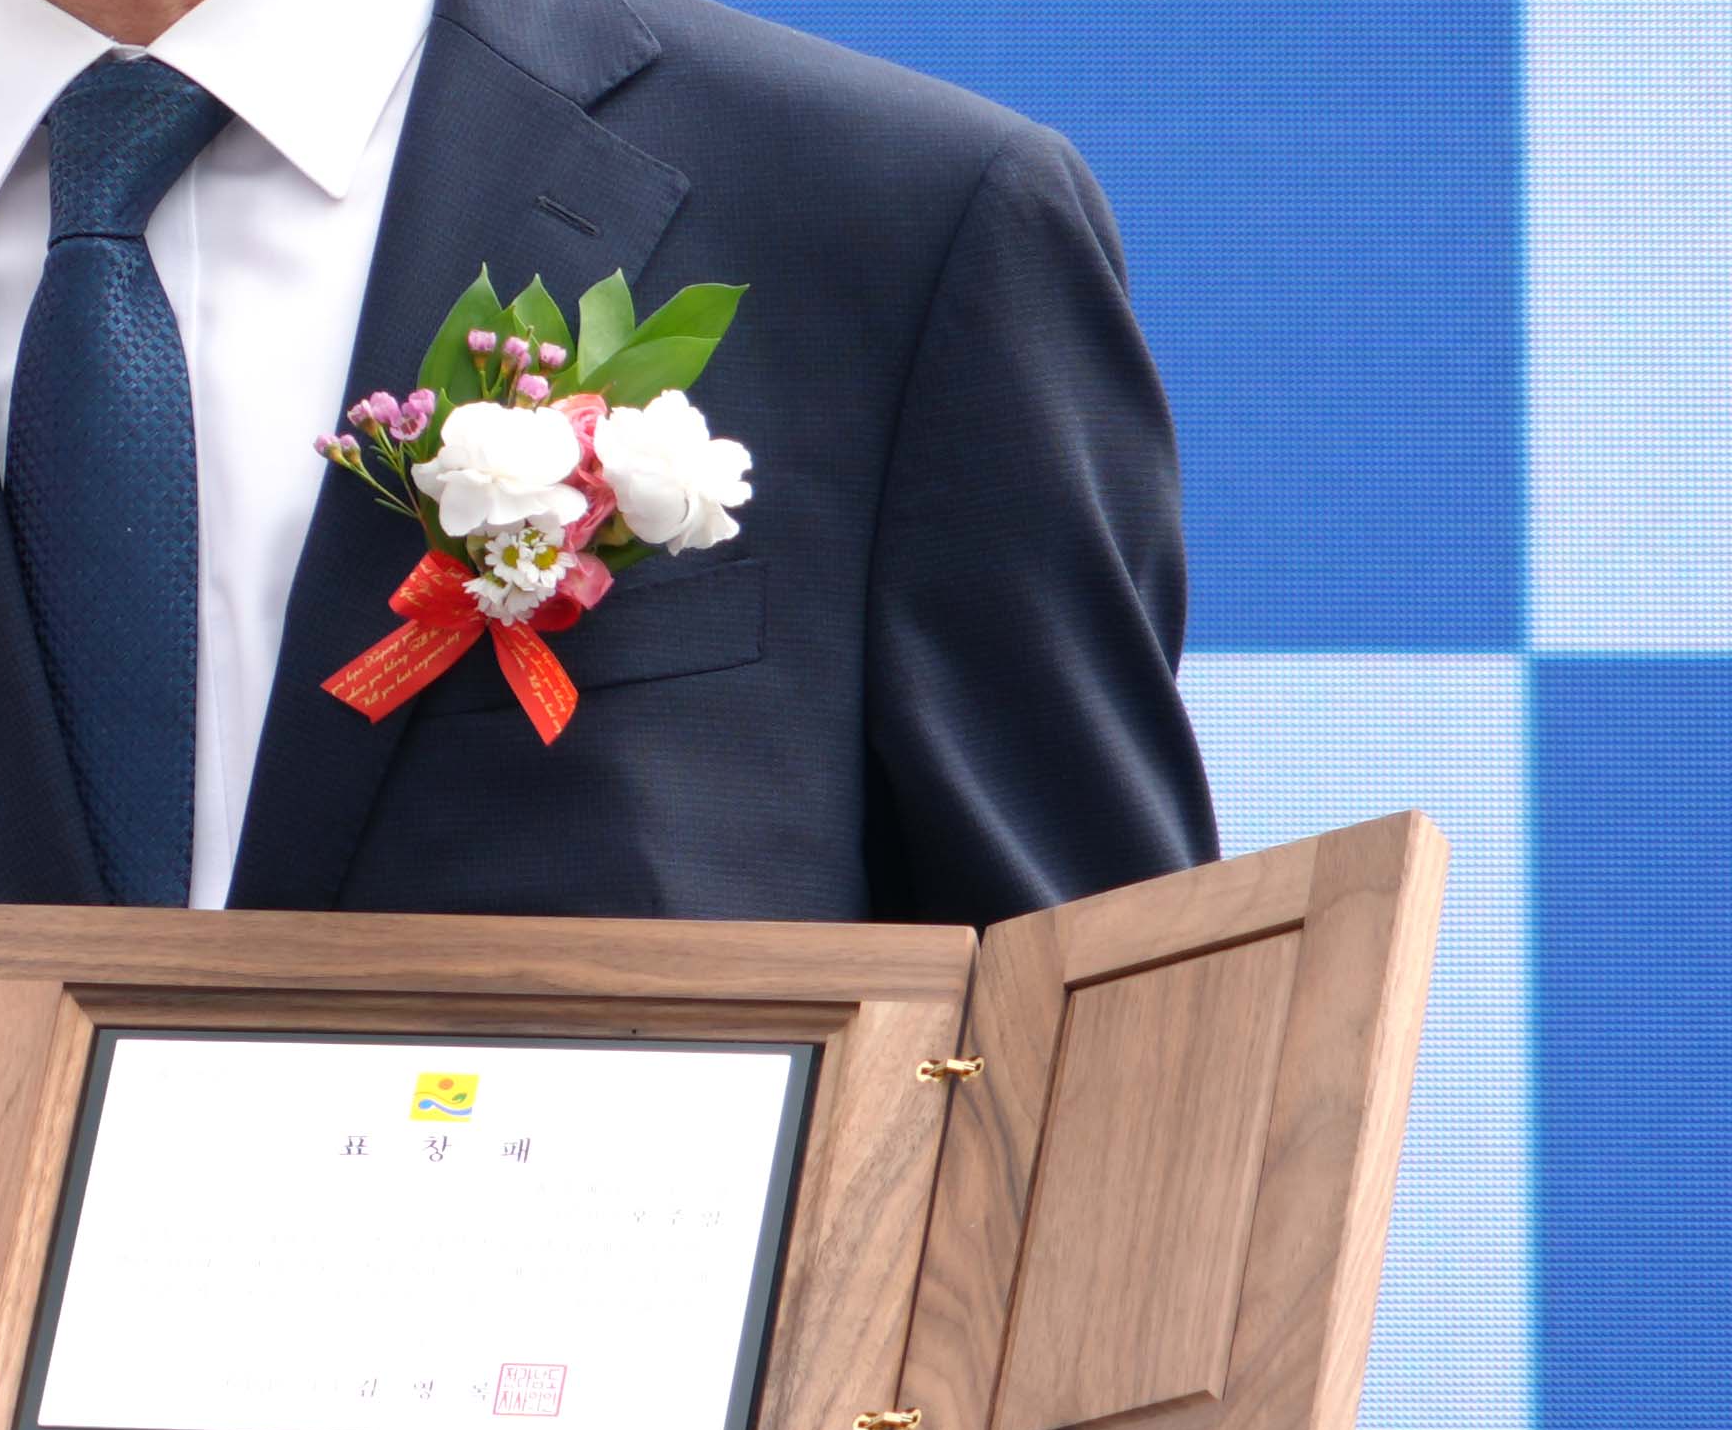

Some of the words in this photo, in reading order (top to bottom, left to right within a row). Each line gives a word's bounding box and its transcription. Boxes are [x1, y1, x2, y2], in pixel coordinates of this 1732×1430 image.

[339, 1135, 369, 1157] 표
[421, 1135, 451, 1163] 창
[501, 1137, 532, 1164] 패
